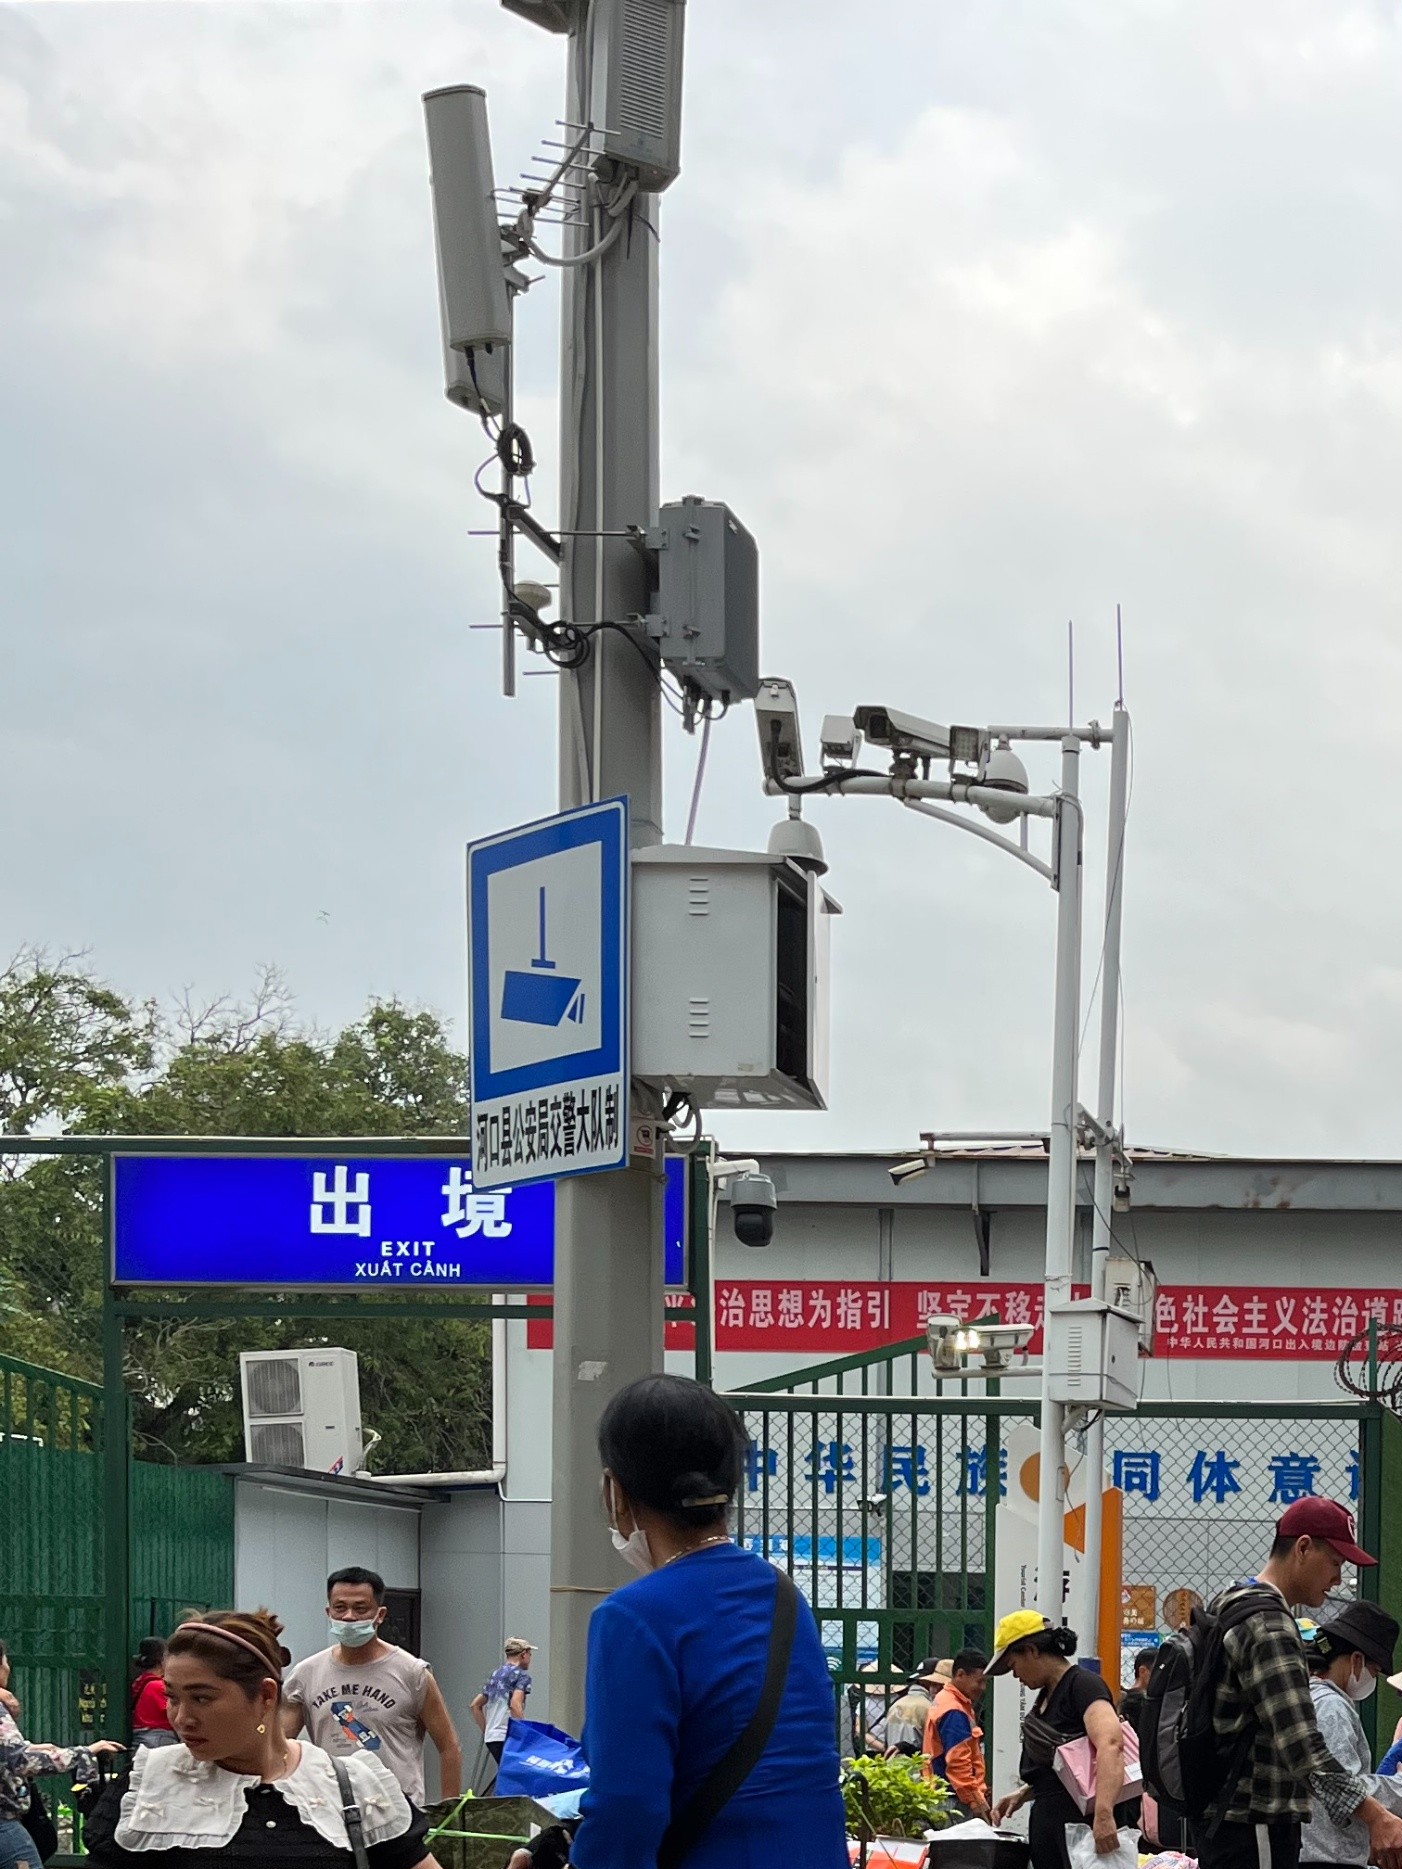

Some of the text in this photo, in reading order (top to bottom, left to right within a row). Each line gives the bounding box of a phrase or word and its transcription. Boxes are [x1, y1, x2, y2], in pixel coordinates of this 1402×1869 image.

[477, 1083, 619, 1172] 河口县公安局交警大队制
[310, 1165, 513, 1239] 出境
[381, 1241, 436, 1257] EXIT
[341, 1683, 359, 1696] ME
[361, 1685, 396, 1710] HAND
